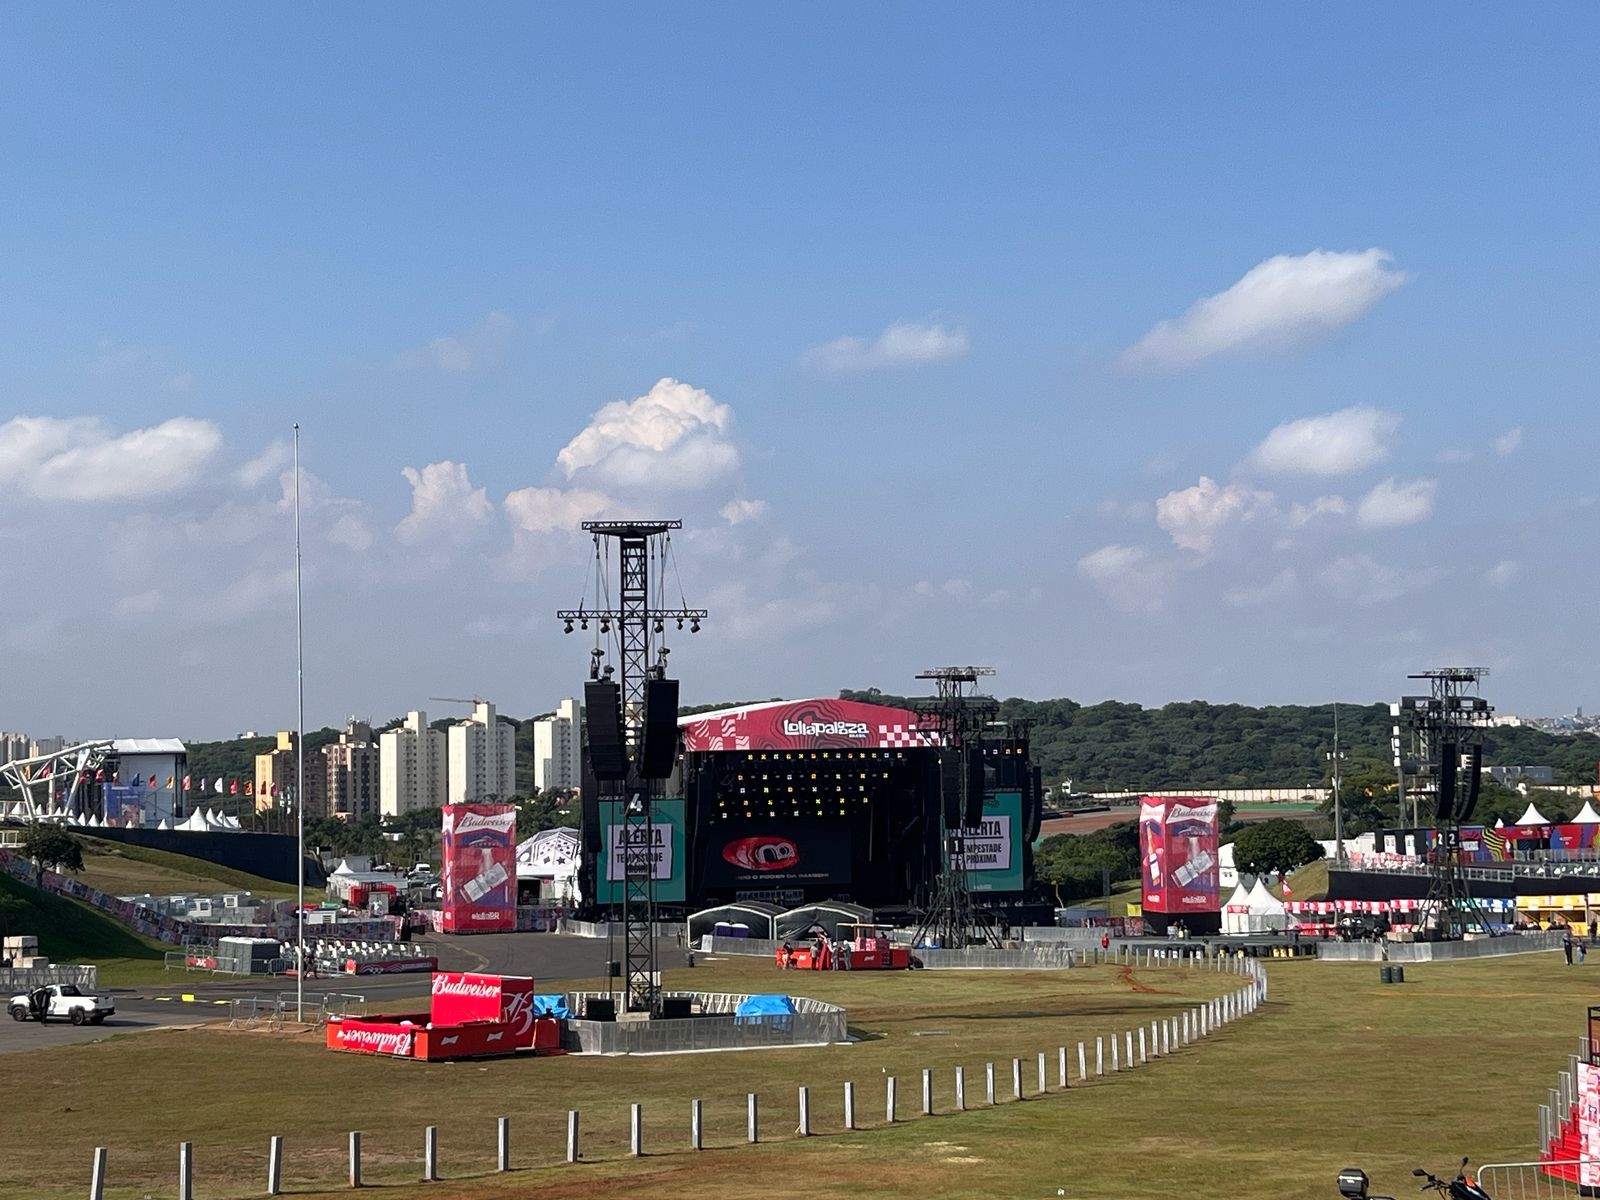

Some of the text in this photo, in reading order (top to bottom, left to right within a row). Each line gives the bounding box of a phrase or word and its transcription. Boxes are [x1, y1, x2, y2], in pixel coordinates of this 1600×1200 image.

[784, 719, 869, 736] Lollapalooza
[1170, 807, 1215, 819] Budweiser
[461, 816, 513, 828] Budweiser
[1448, 833, 1456, 845] 2
[962, 843, 1002, 853] EMPESTADE
[431, 973, 502, 997] Budweiser
[342, 1029, 411, 1055] Budweiser
